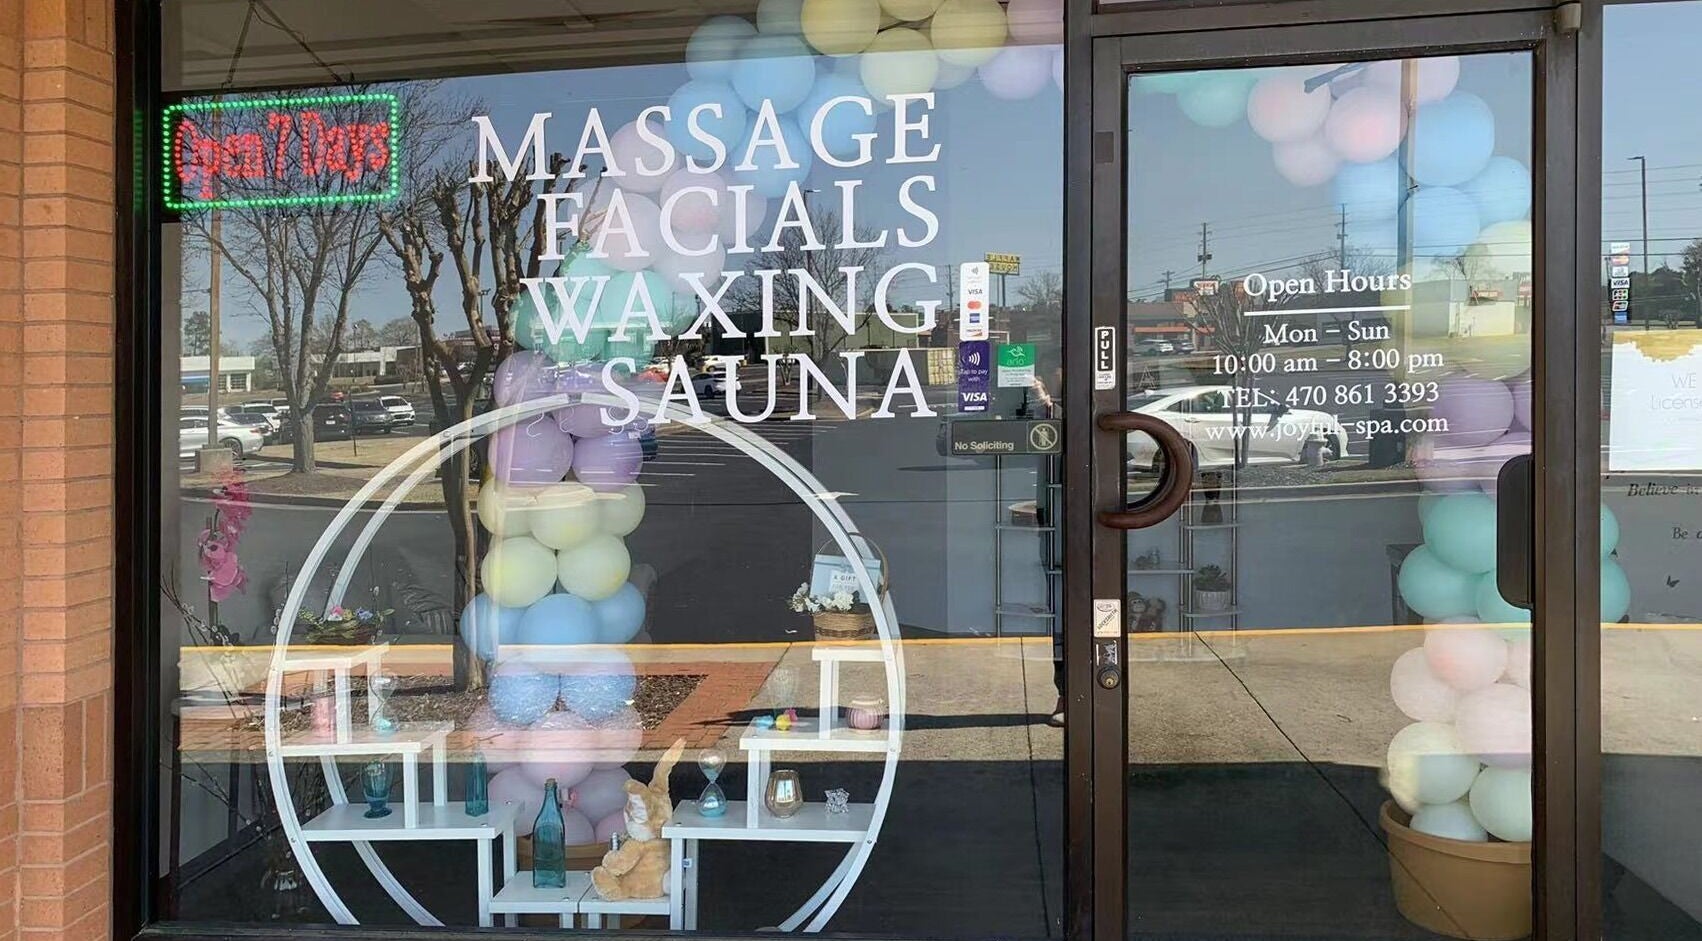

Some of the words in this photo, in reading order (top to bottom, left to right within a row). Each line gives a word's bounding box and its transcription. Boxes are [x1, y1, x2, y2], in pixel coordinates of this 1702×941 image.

[468, 92, 941, 184] MASSAGE
[174, 119, 265, 199] Open
[268, 112, 292, 180] 7
[300, 110, 390, 182] Days
[537, 175, 940, 261] FACIALS
[1243, 273, 1316, 301] Open
[1323, 270, 1412, 293] Hours
[520, 262, 942, 345] WAXING
[1263, 323, 1319, 344] Mon
[1348, 321, 1391, 341] Sun
[1100, 330, 1110, 370] PULL
[1212, 353, 1276, 375] 10:00
[1283, 358, 1319, 372] am
[1348, 349, 1399, 370] 8:00
[1407, 352, 1444, 374] pm
[600, 347, 937, 427] SAUNA
[1672, 372, 1696, 389] WE
[962, 392, 987, 402] VISA
[1217, 388, 1276, 409] TEL:
[1285, 385, 1327, 406] 470
[1334, 383, 1374, 405] 861
[1384, 382, 1439, 403] 3393
[954, 442, 968, 450] No
[970, 440, 1015, 451] Soliciting
[1627, 482, 1679, 497] Believe
[1672, 526, 1689, 540] Be
